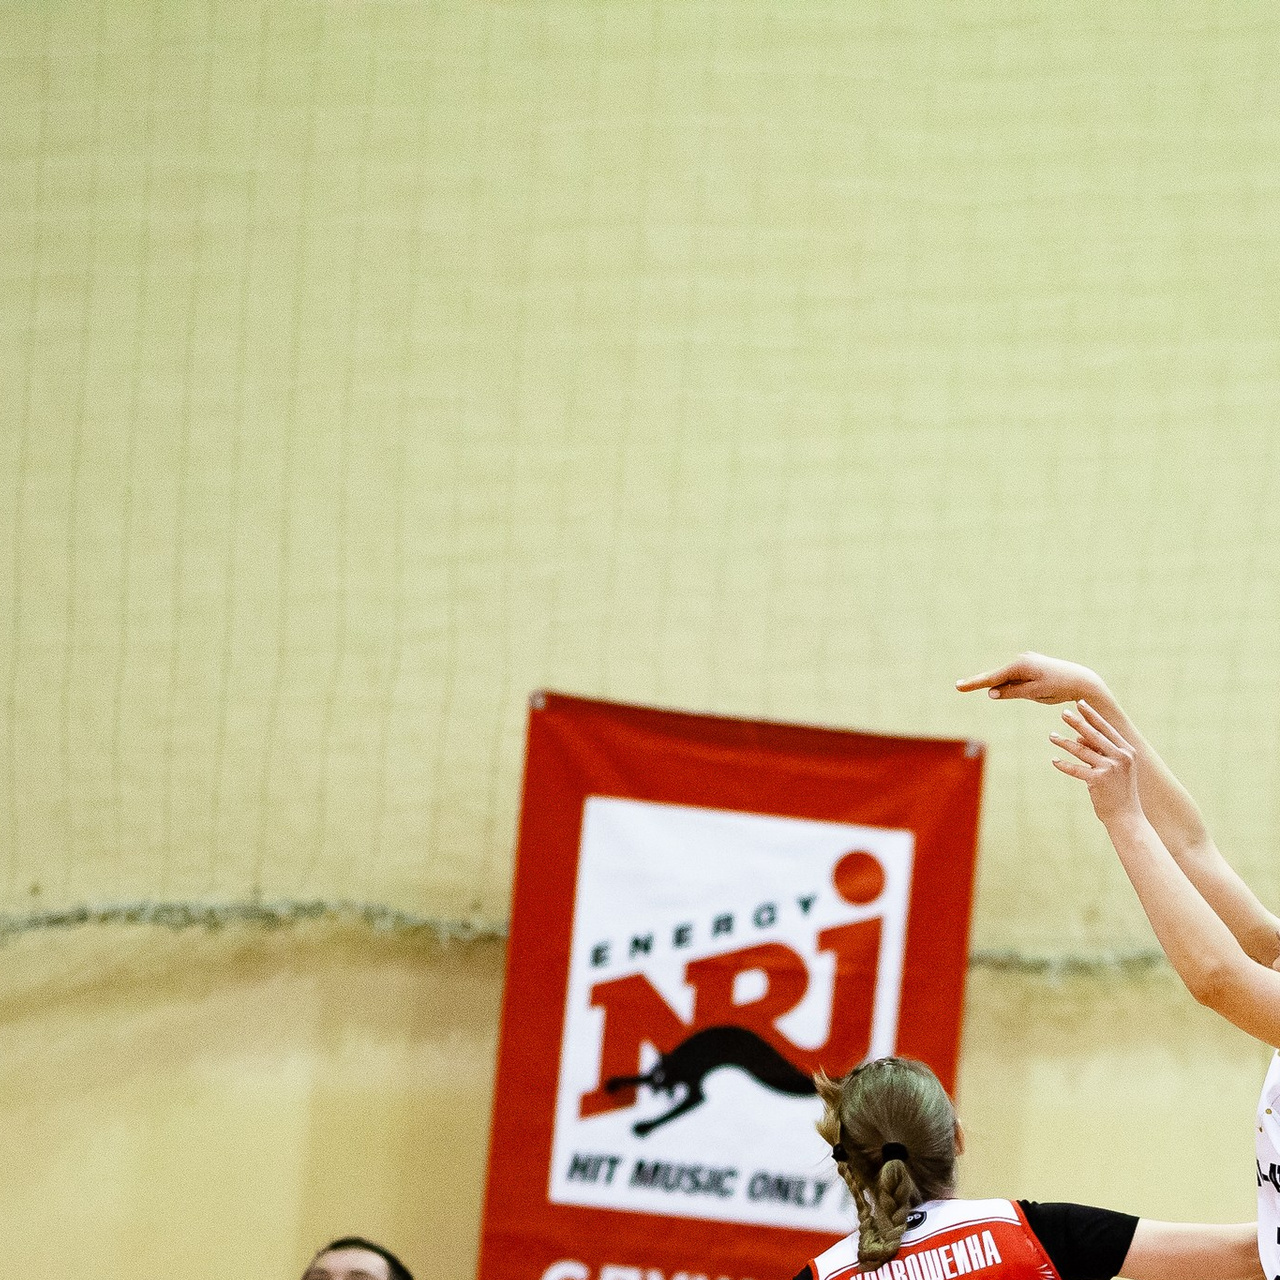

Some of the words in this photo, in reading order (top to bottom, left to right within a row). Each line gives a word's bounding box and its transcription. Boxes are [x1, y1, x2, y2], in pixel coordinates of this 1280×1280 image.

[590, 894, 816, 968] ENERGY
[567, 1153, 621, 1185] HIT
[628, 1159, 739, 1199] MUSIC
[747, 1169, 829, 1208] ONLY
